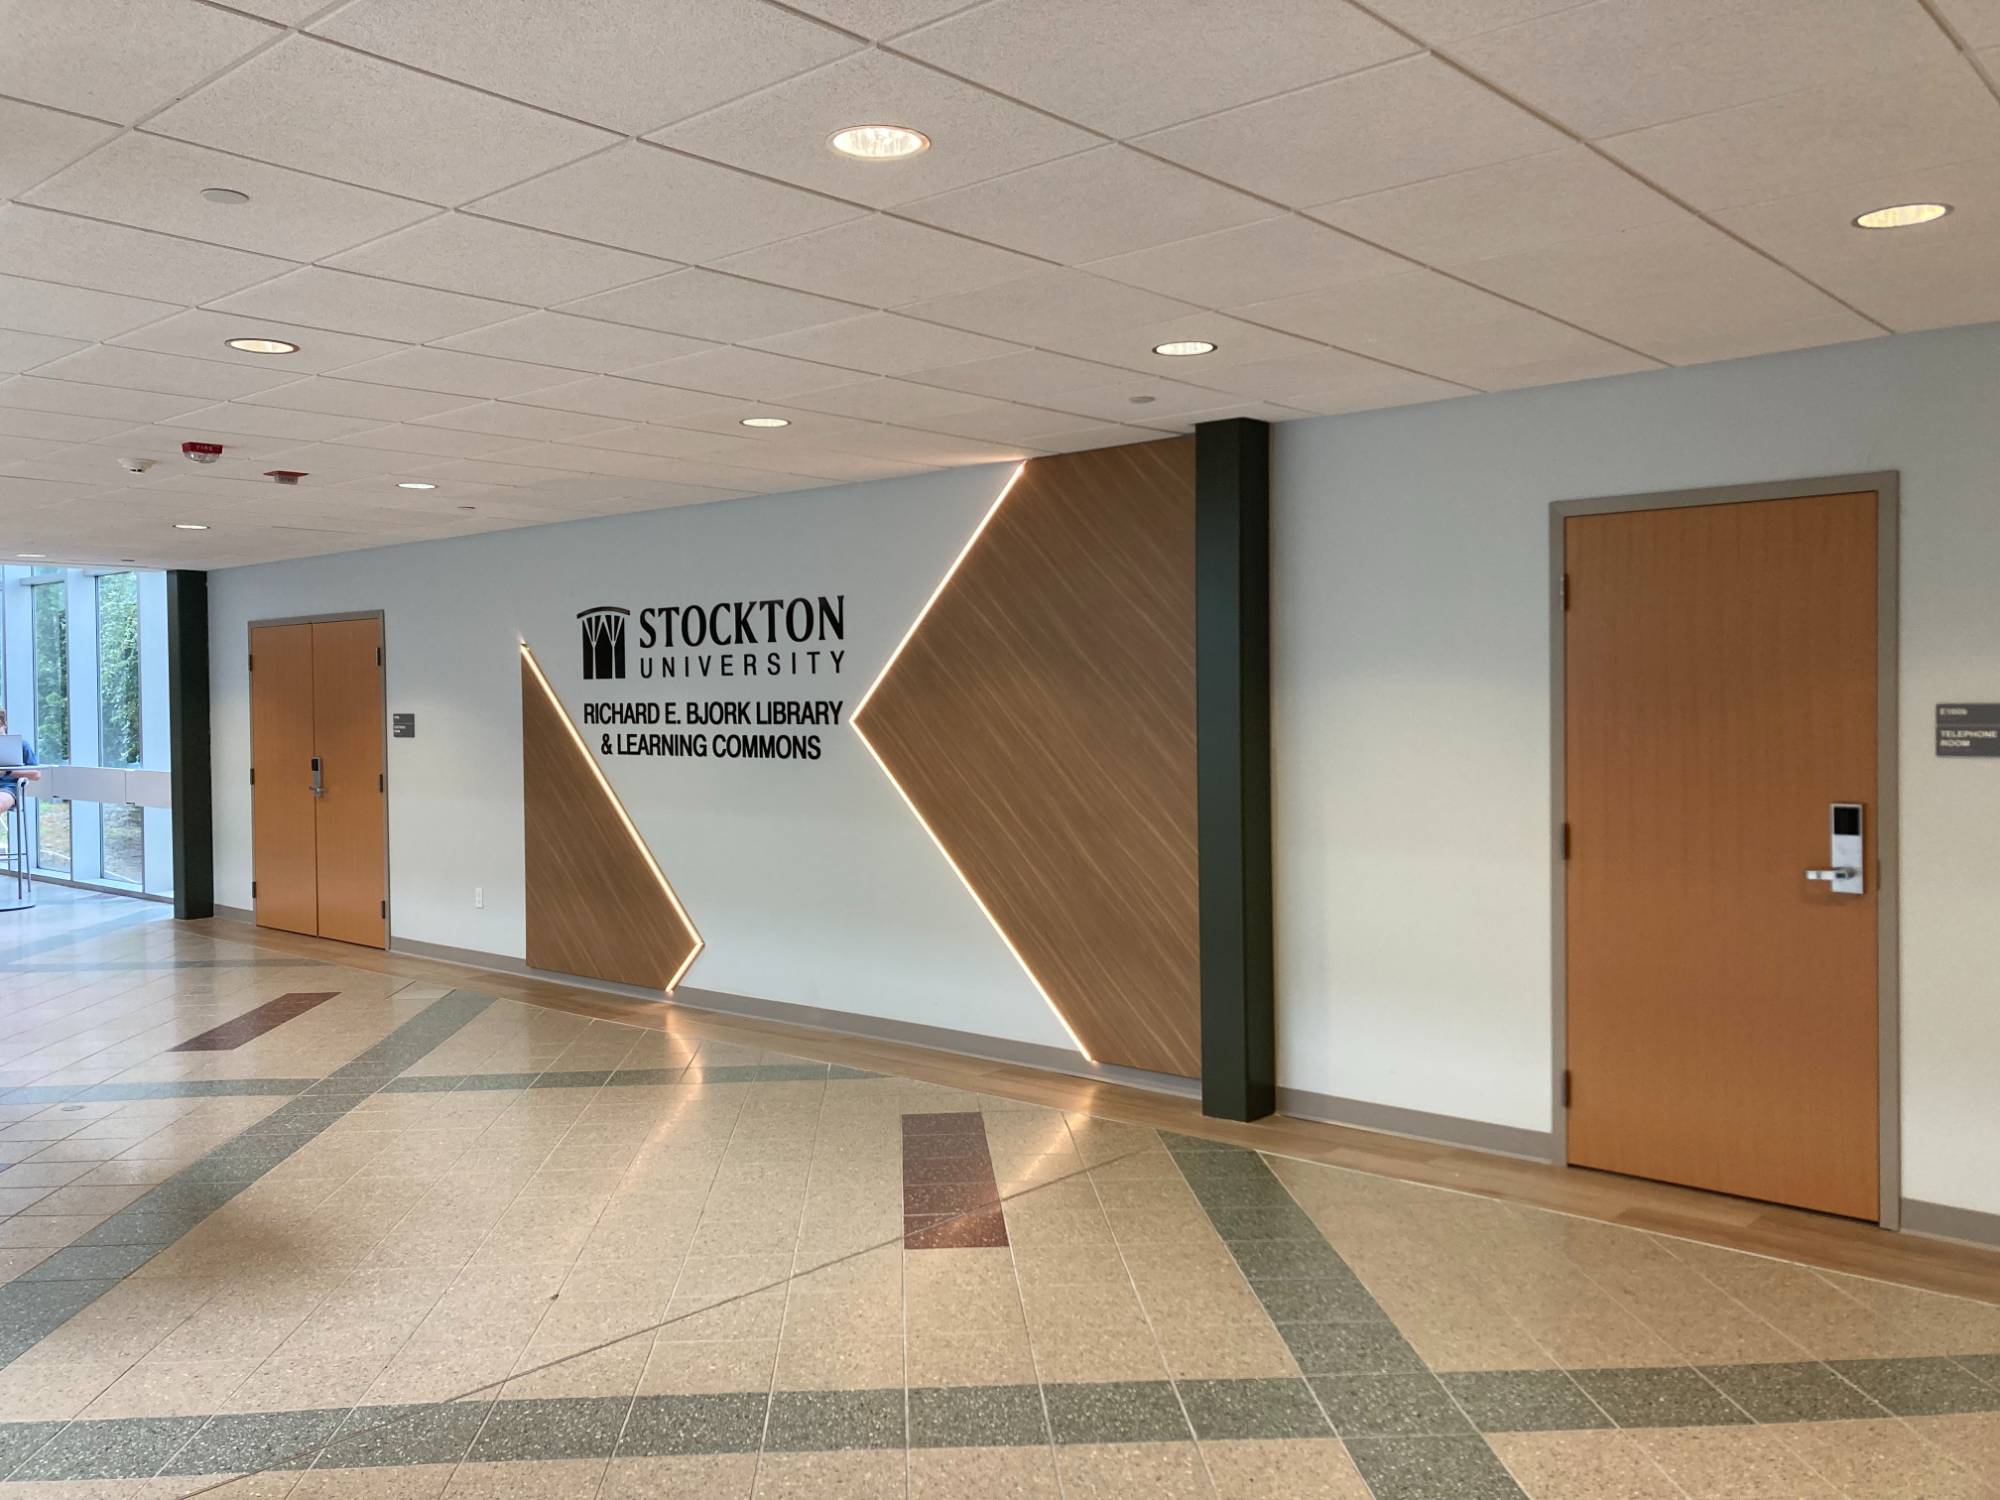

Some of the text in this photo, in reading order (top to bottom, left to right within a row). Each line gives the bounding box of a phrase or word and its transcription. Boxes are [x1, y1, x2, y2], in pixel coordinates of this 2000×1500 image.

[639, 594, 845, 649] STOCKTON
[640, 650, 845, 679] UNIVERSITY
[583, 700, 844, 726] RICHARD E. BJORK LIBRARY
[600, 733, 822, 761] & LEARNING COMMONS
[1940, 730, 1998, 738] TELEPHONE
